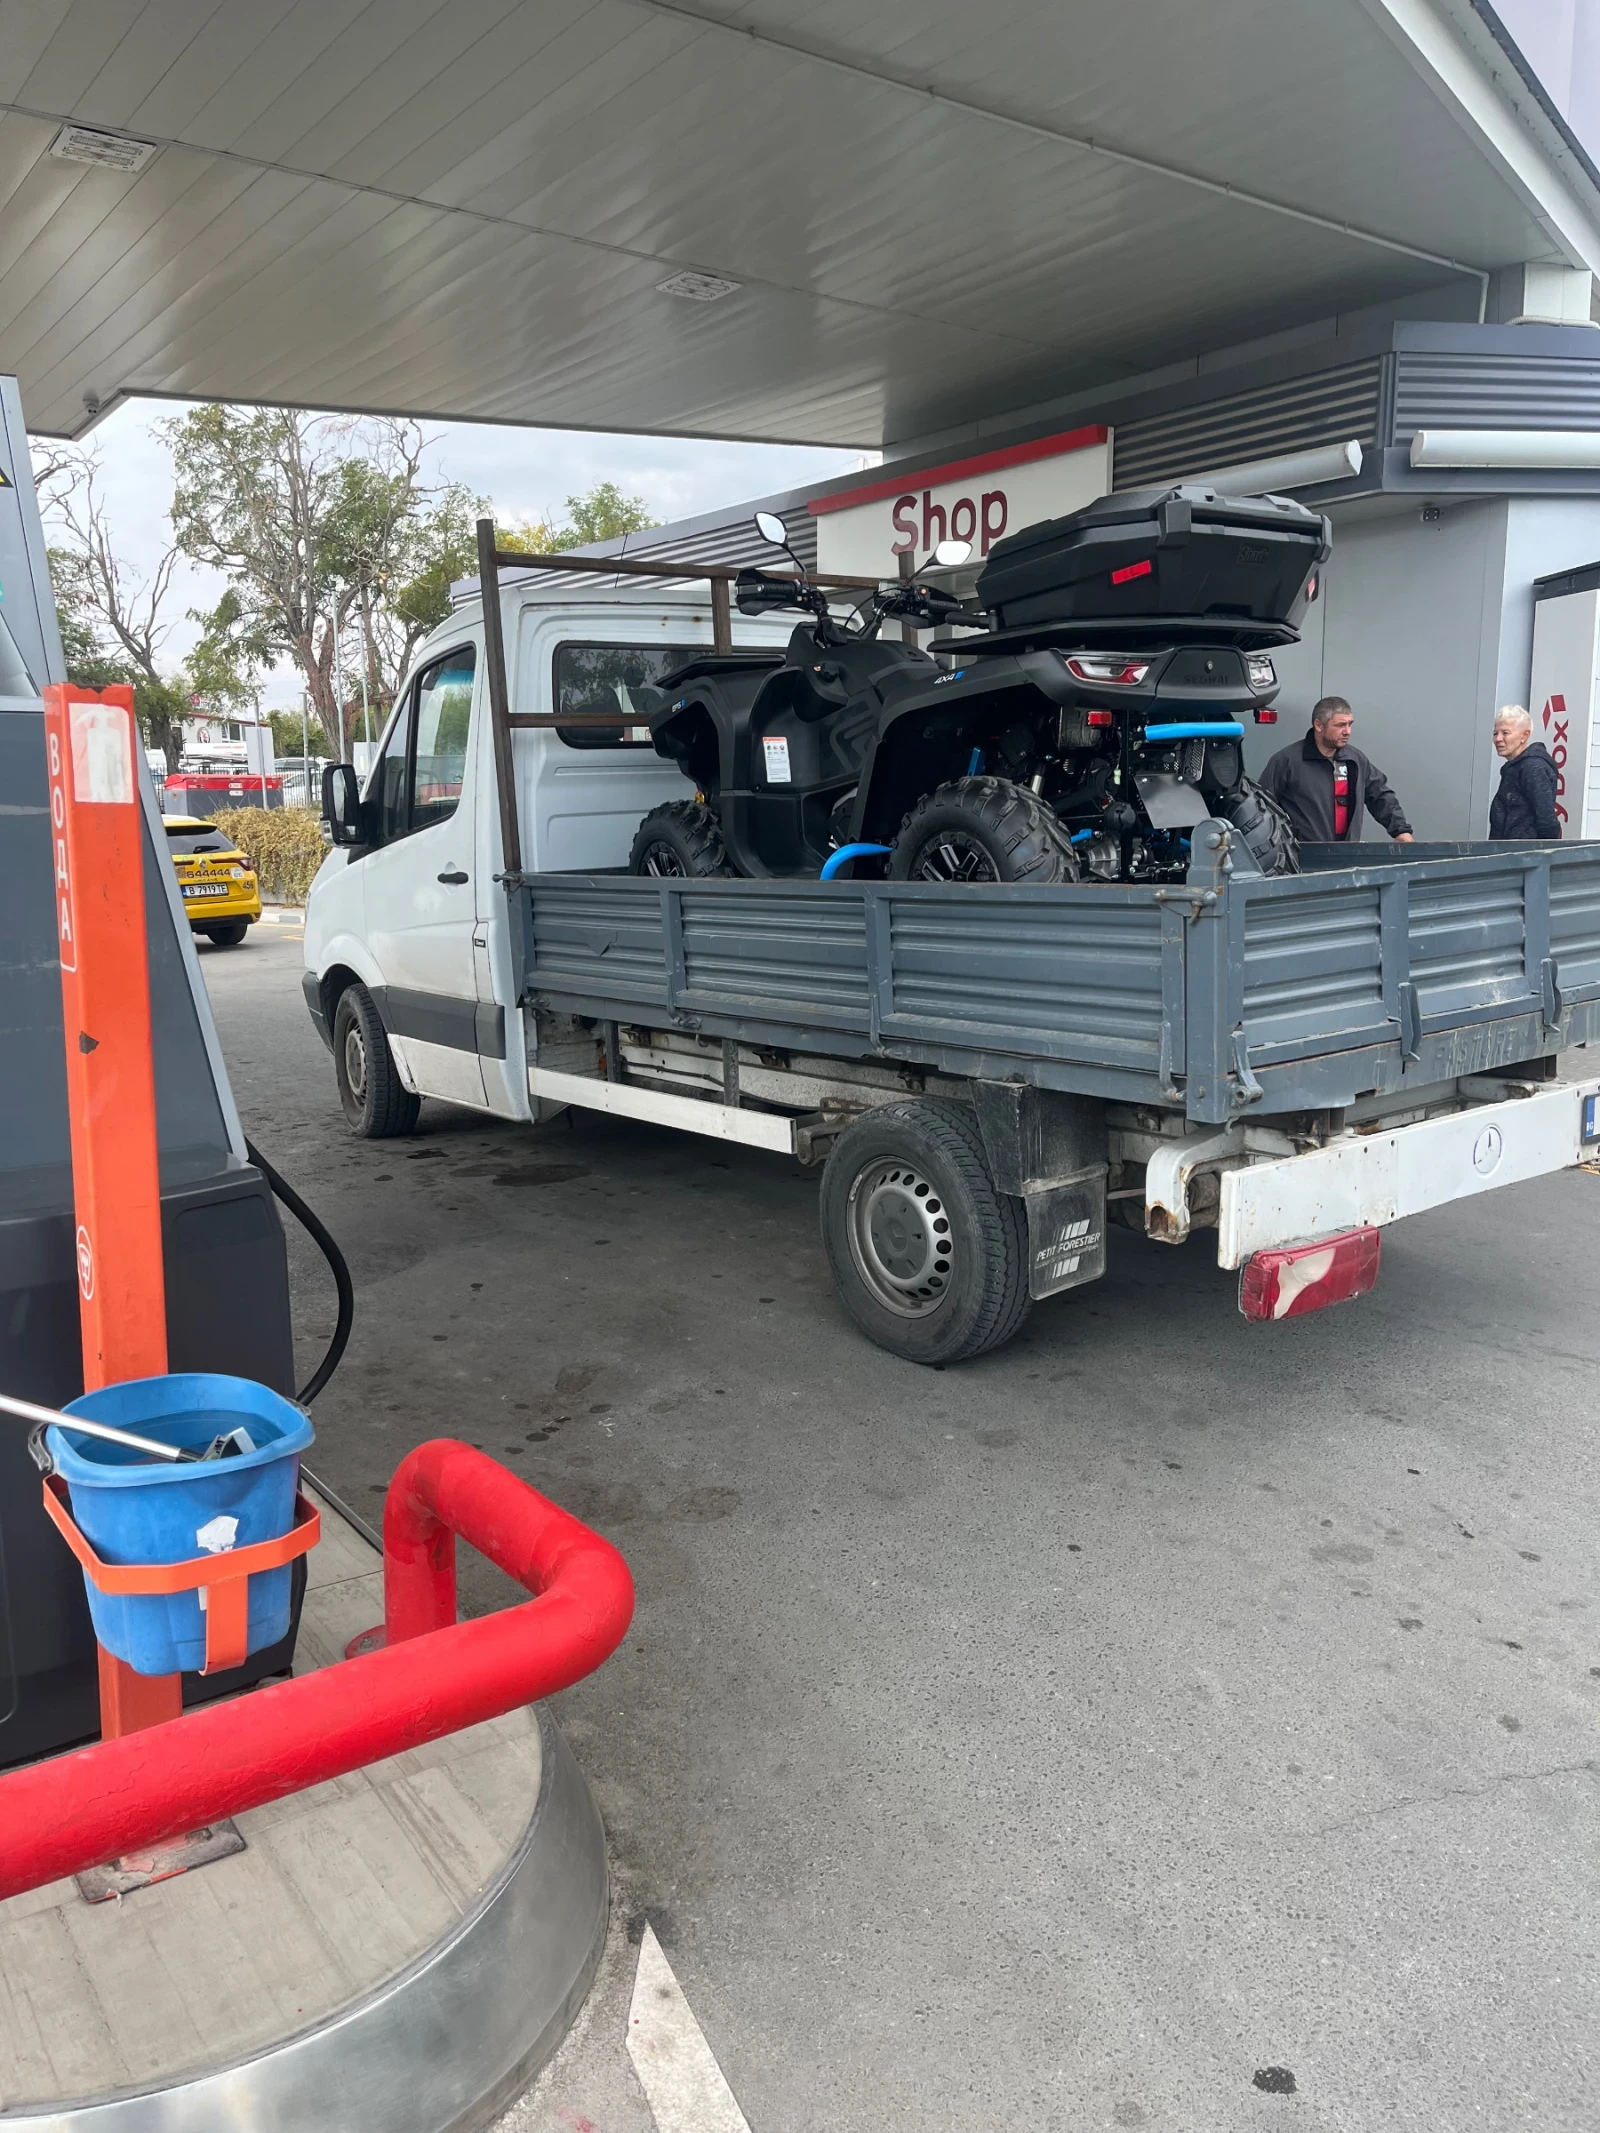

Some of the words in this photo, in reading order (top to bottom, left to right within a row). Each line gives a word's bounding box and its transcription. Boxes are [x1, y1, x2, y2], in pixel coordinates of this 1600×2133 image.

[891, 490, 1008, 557] Shop
[1183, 675, 1229, 685] SEGWAY
[186, 869, 231, 878] 644444
[1586, 1121, 1594, 1131] BG
[1036, 1246, 1057, 1262] PETIT
[1057, 1232, 1101, 1253] FORESTIER
